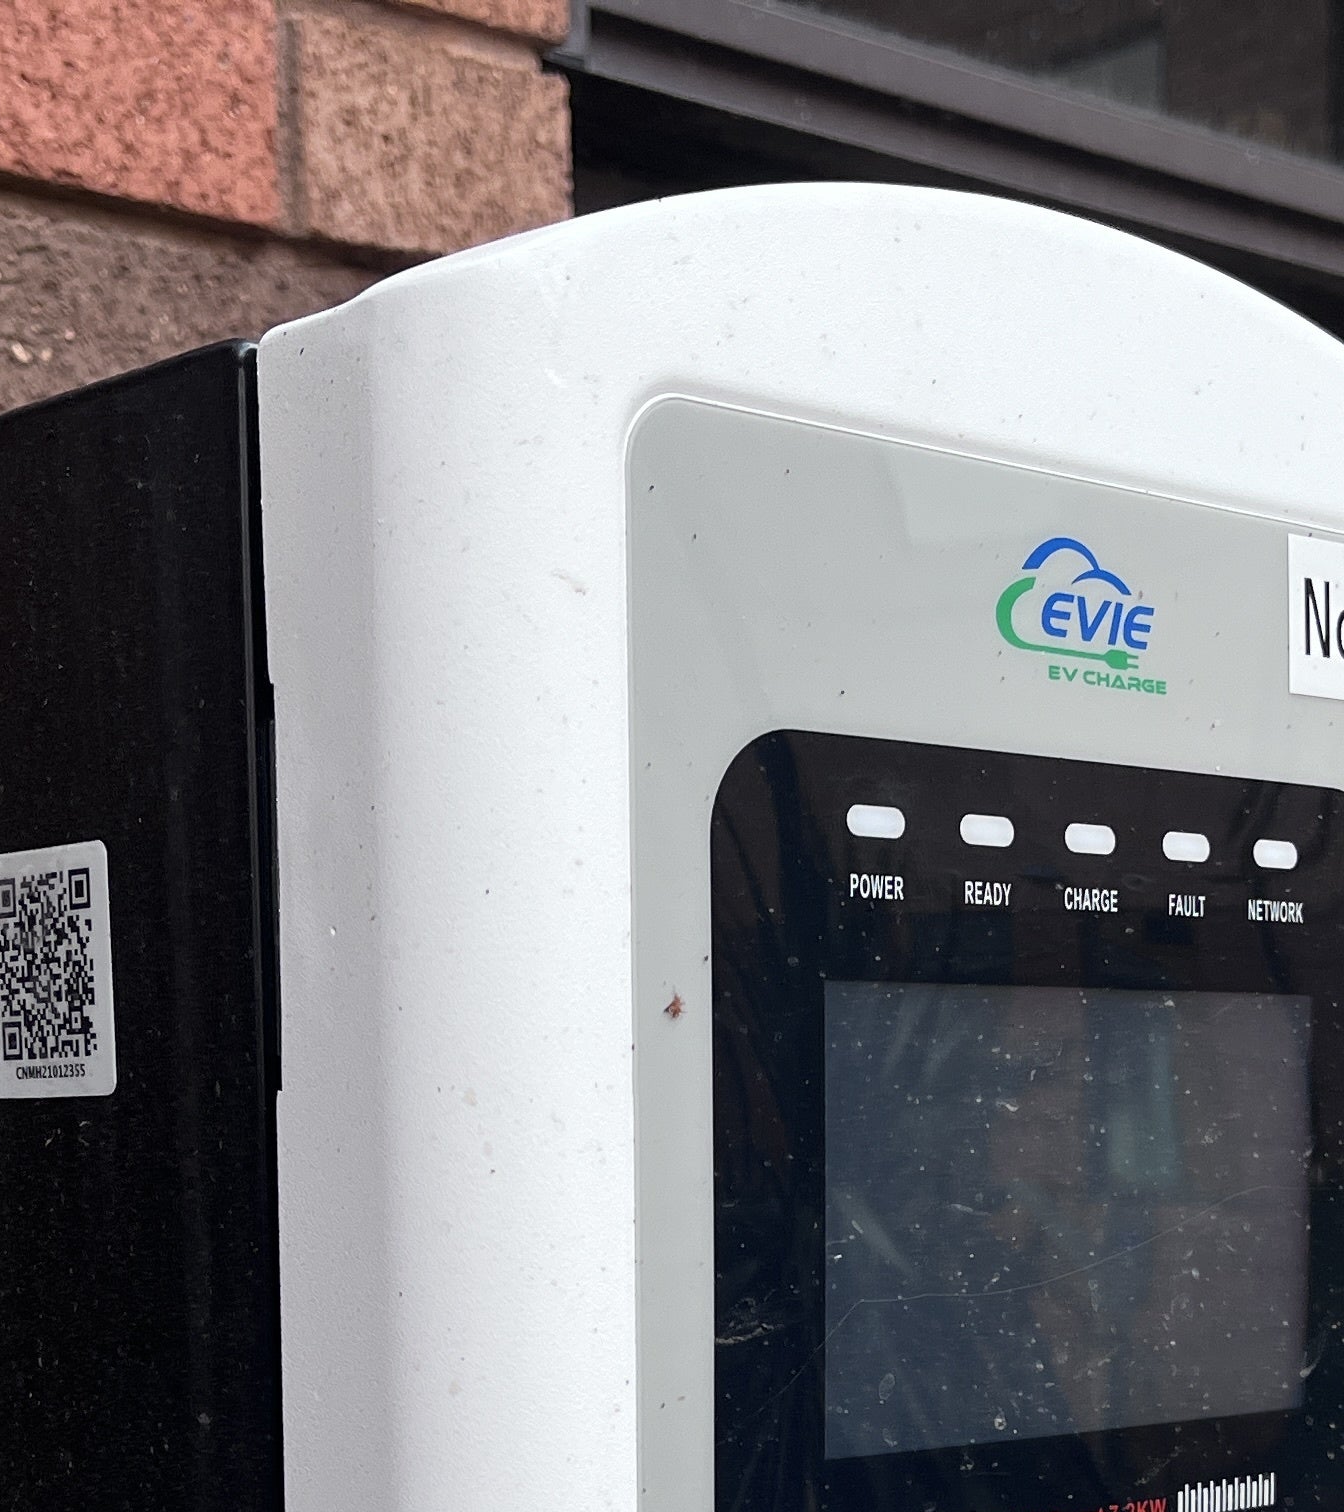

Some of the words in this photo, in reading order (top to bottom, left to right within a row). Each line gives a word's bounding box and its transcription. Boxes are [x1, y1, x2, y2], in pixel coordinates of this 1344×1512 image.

[1041, 592, 1155, 650] EVIE
[1048, 664, 1078, 682] EV
[1083, 671, 1167, 695] CHARGE
[849, 873, 904, 900] POWER
[964, 880, 1012, 906] READY
[1064, 887, 1119, 913] CHARGE
[1168, 894, 1205, 917] FAULT
[1247, 900, 1304, 924] NETWORK
[16, 1063, 86, 1080] CNMH21012355
